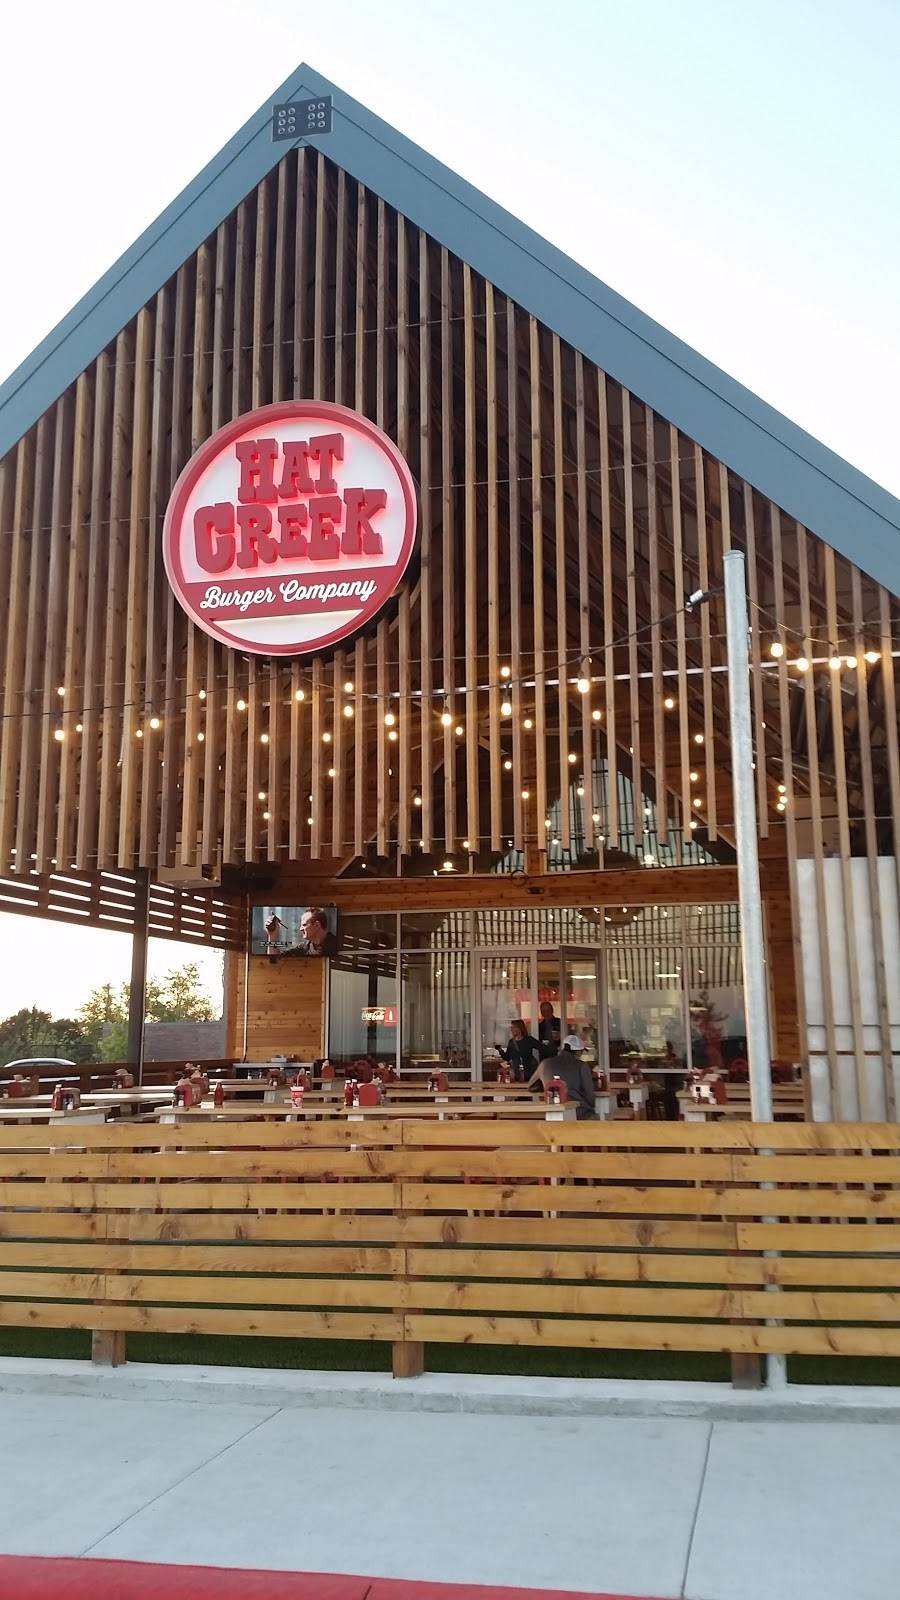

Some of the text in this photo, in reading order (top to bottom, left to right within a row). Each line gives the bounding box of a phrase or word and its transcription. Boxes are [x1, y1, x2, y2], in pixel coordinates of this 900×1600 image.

[236, 433, 344, 504] HAT
[193, 488, 387, 573] CREEK
[200, 579, 377, 612] Burger Company
